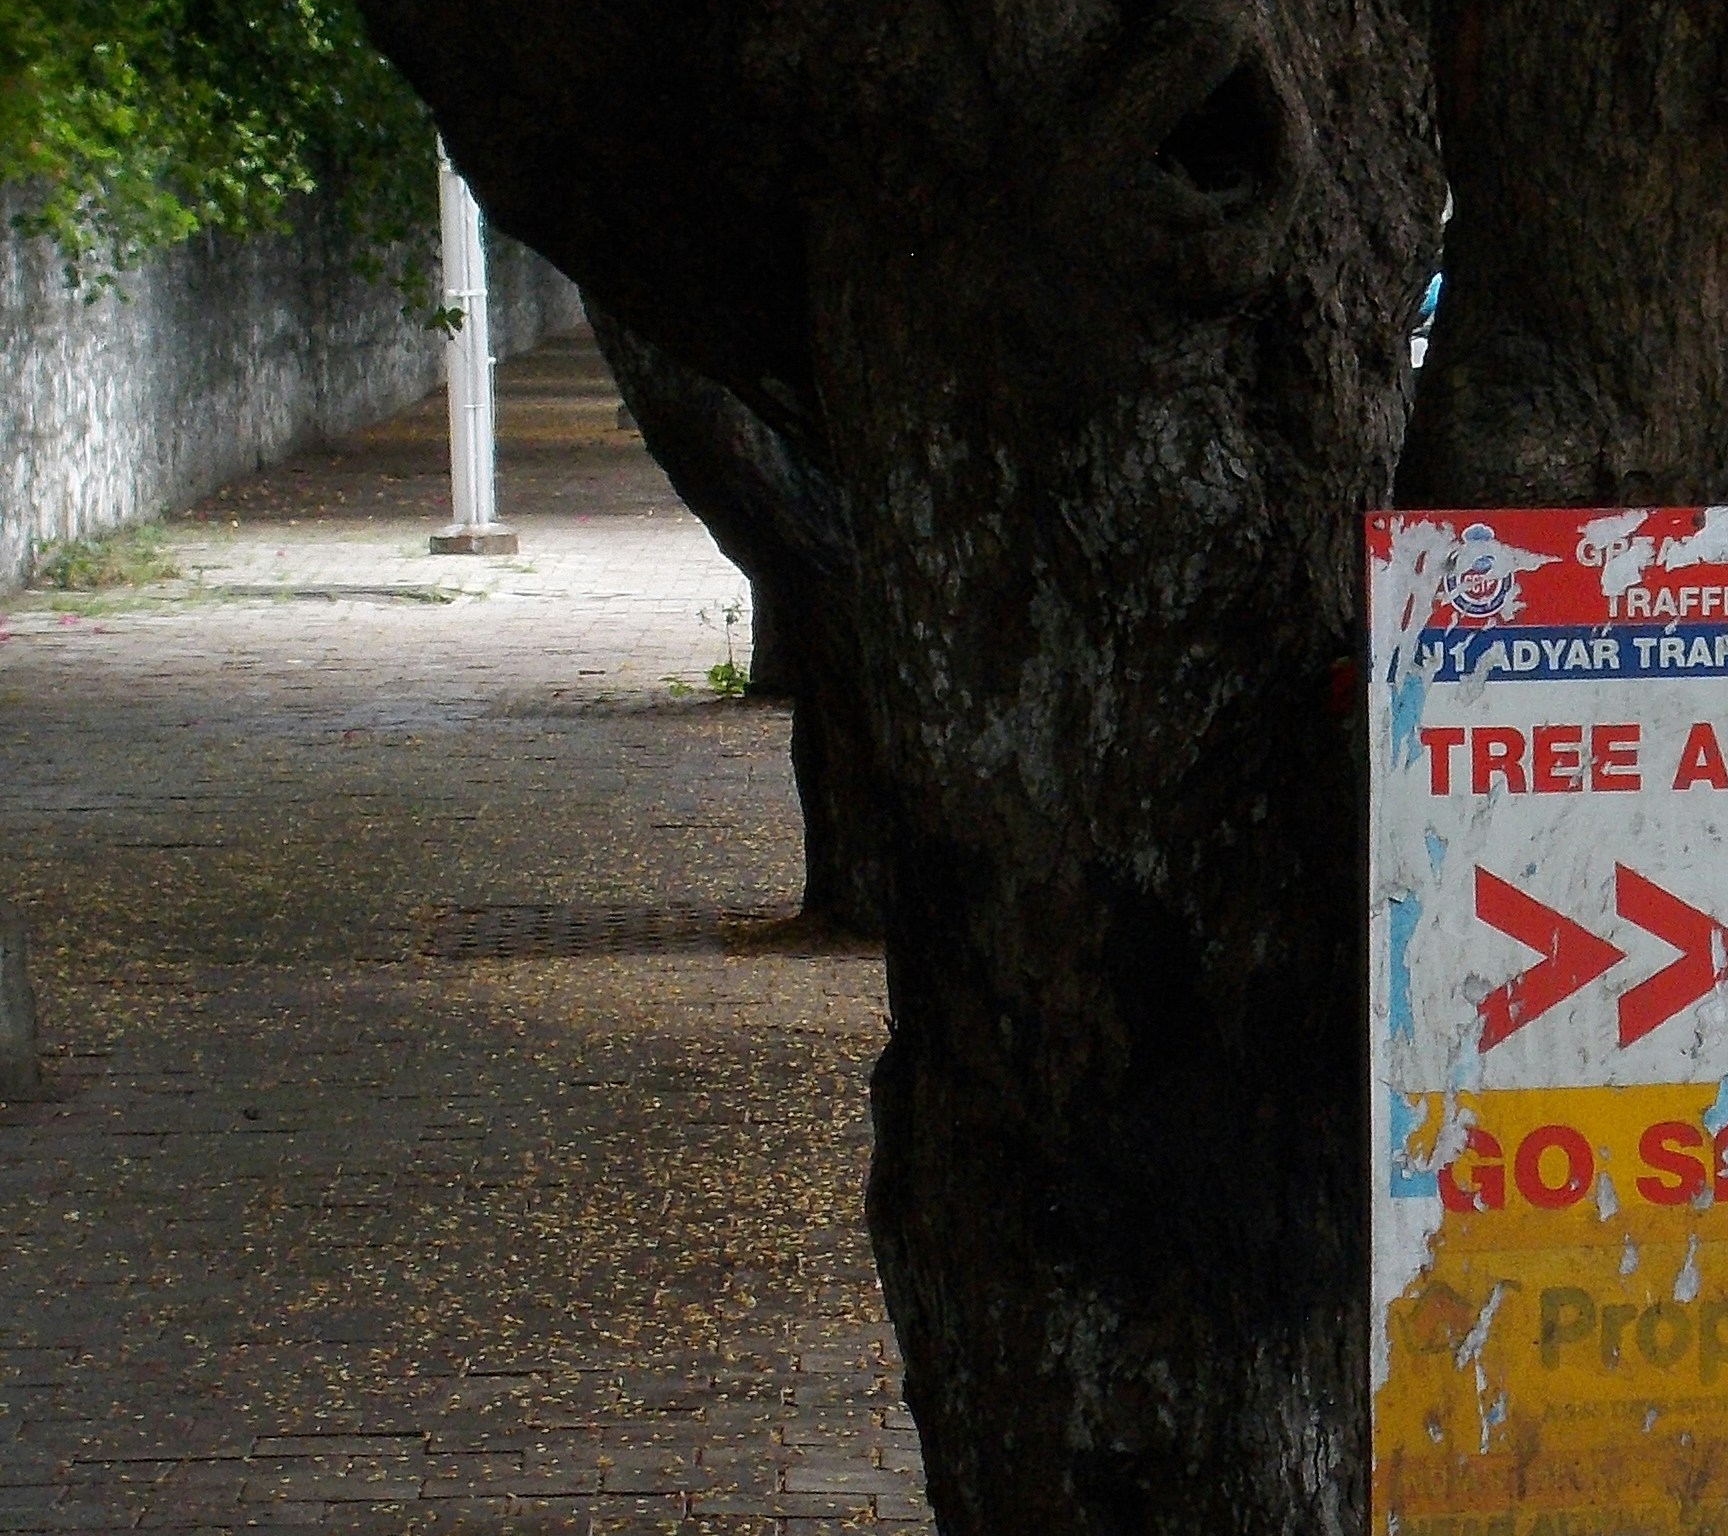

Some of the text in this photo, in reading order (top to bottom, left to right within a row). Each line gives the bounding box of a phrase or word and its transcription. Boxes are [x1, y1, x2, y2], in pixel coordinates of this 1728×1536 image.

[1488, 637, 1621, 671] ADYAR
[1420, 722, 1642, 796] TREE
[1436, 1124, 1595, 1213] GO
